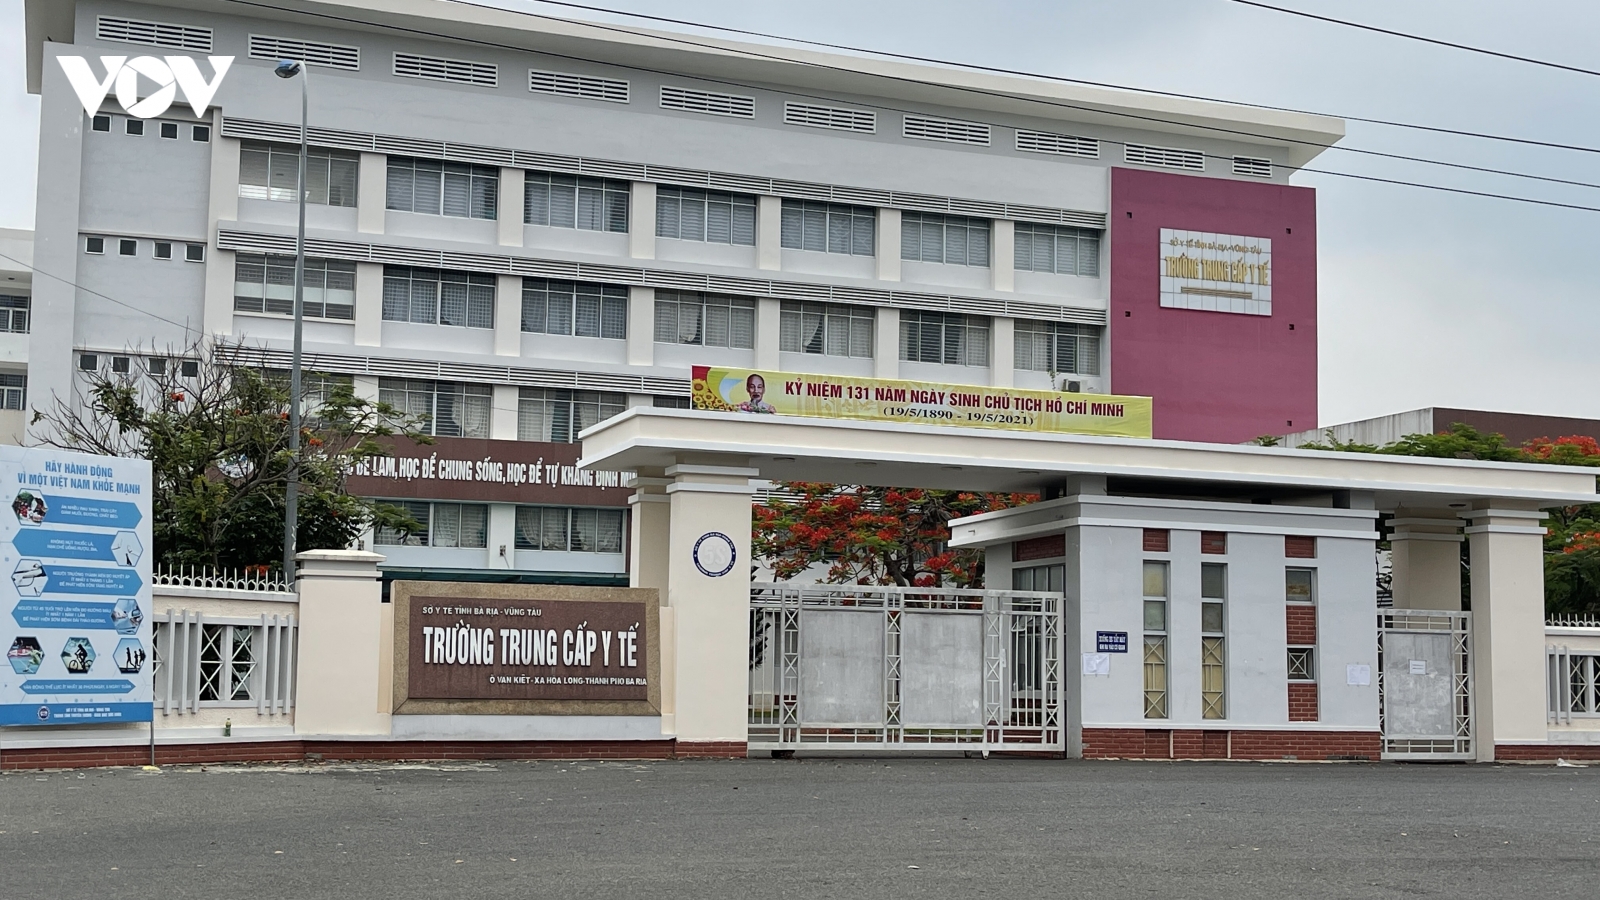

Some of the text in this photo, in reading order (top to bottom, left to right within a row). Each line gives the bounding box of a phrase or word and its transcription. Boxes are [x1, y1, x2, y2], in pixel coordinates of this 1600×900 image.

[1165, 252, 1269, 286] TRƯỜNG TRUNG CẤP Y TẾ
[785, 378, 803, 396] KỶ
[807, 382, 842, 400] NIỆM
[847, 386, 869, 400] 131
[875, 386, 906, 403] NĂM
[911, 388, 945, 406] NGÀY
[949, 393, 980, 408] SINH
[985, 392, 1010, 410] CHỦ
[1014, 398, 1042, 414] TỊCH
[1067, 400, 1087, 415] CHÍ
[1091, 402, 1124, 418] MINH
[884, 406, 952, 420] (19/5/1890
[967, 412, 1034, 426] 19/5/2021)
[45, 460, 113, 479] HÃY HÀNH ĐỘNG
[399, 458, 420, 482] HỌC
[422, 452, 436, 478] ĐỂ
[438, 459, 473, 482] CHUNG
[476, 456, 506, 484] SỐNG,
[506, 463, 527, 486] HỌC
[528, 458, 543, 484] ĐỂ
[545, 462, 560, 488] TỰ
[595, 470, 618, 490] ĐỊNH
[18, 471, 141, 496] VÌ MỘT VIỆT NAM KHỎE MẠNH
[704, 545, 727, 566] 5S
[422, 604, 434, 614] SỞ
[474, 606, 484, 616] BÀ
[486, 607, 500, 618] RỊA
[504, 606, 526, 616] VŨNG
[527, 606, 542, 616] TÀU
[423, 619, 640, 667] TRƯỜNG TRUNG CẤP Y TẾ
